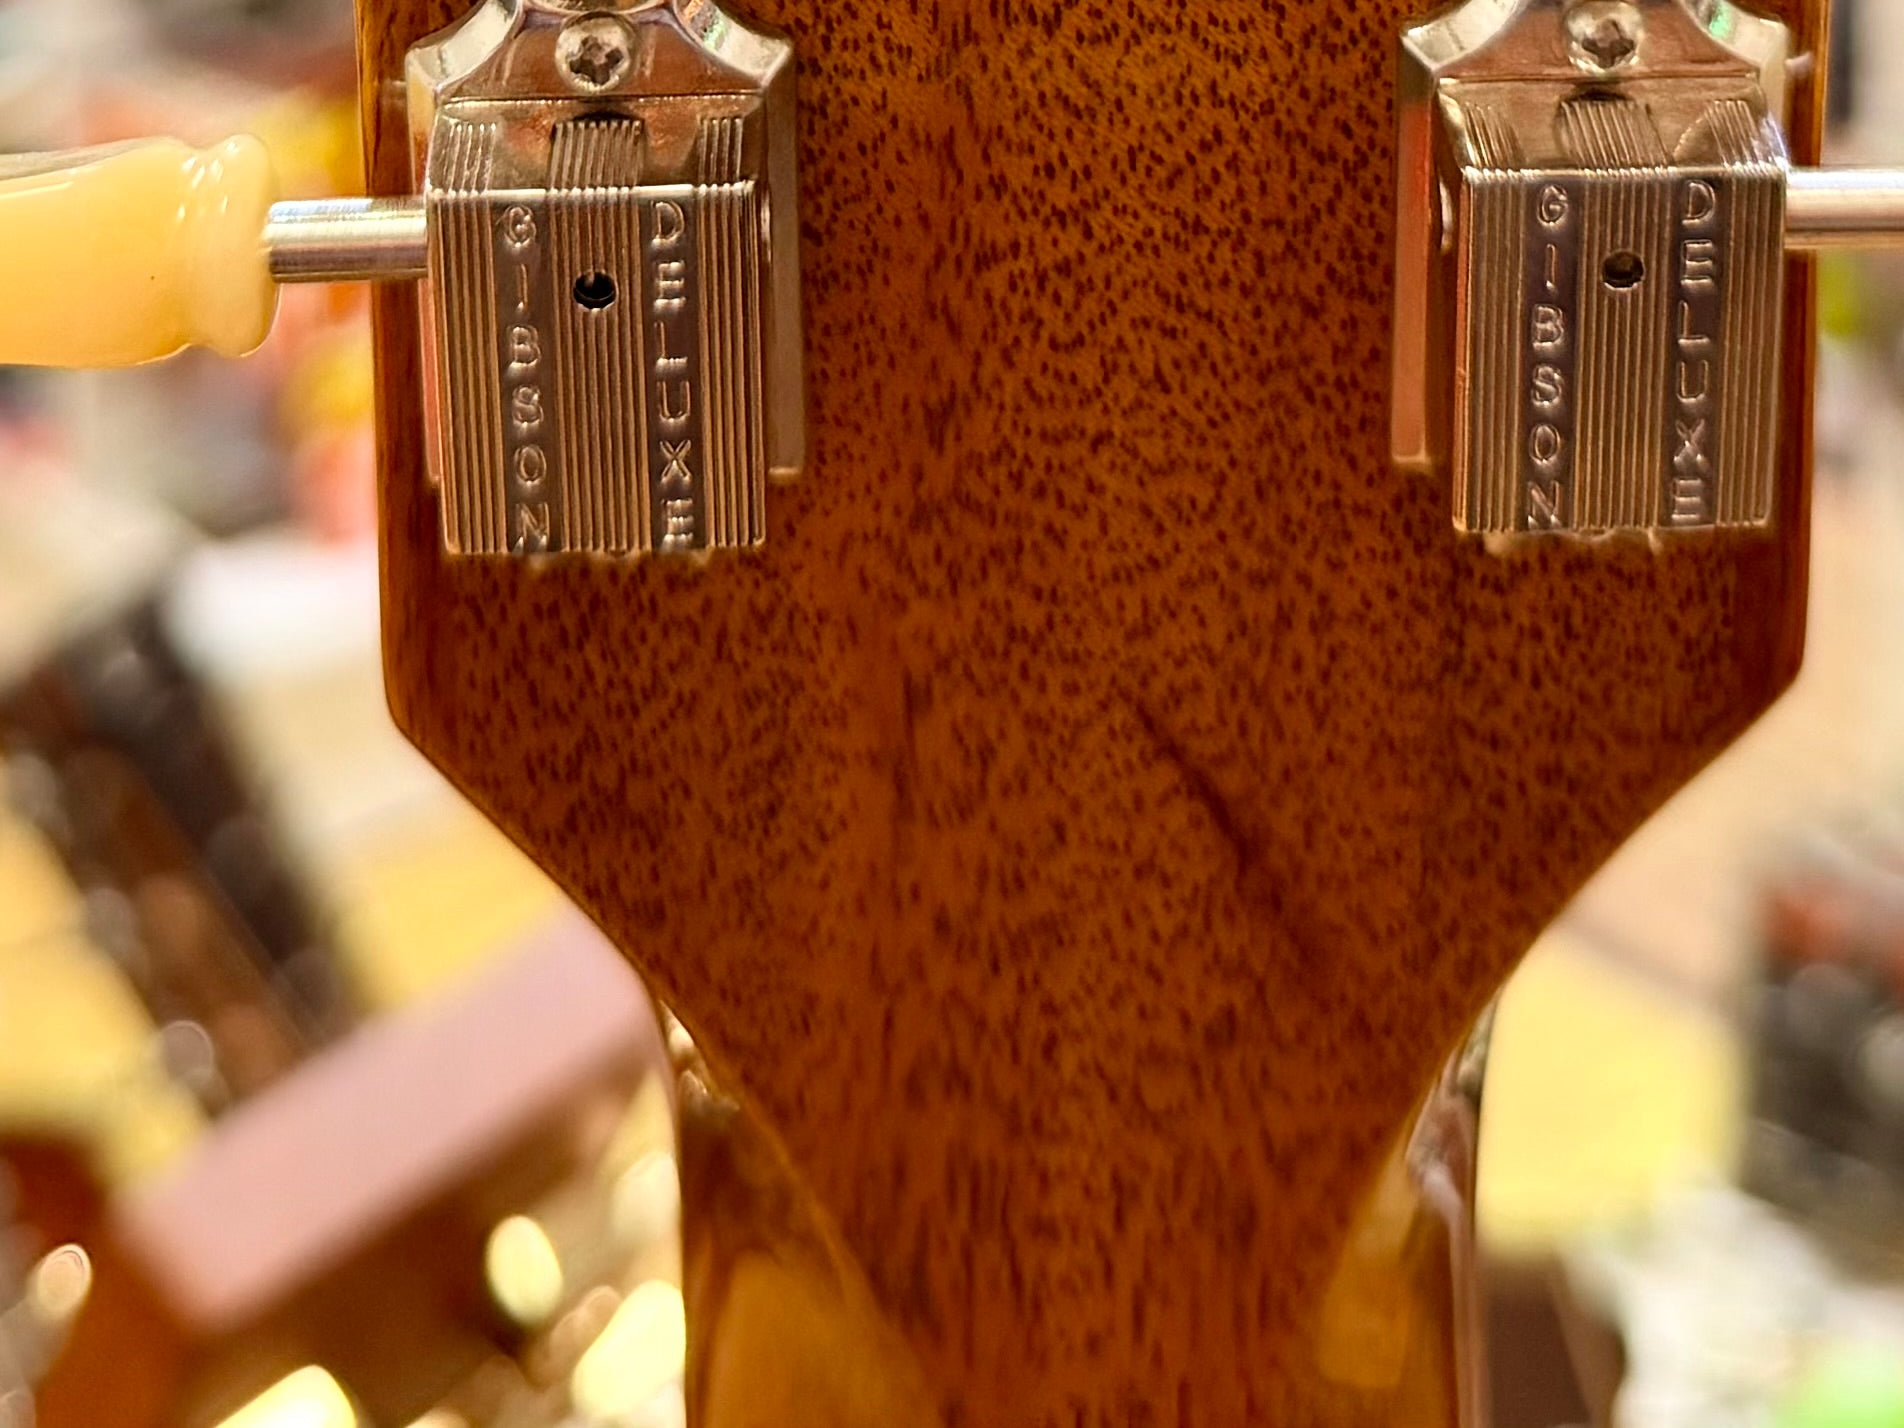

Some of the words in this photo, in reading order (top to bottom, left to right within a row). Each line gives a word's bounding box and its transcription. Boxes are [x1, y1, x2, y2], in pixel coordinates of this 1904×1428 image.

[503, 205, 550, 550] GIBSON
[650, 200, 696, 548] DELUXE
[1527, 184, 1569, 528] GIBSON
[1668, 179, 1716, 522] DELUXE
